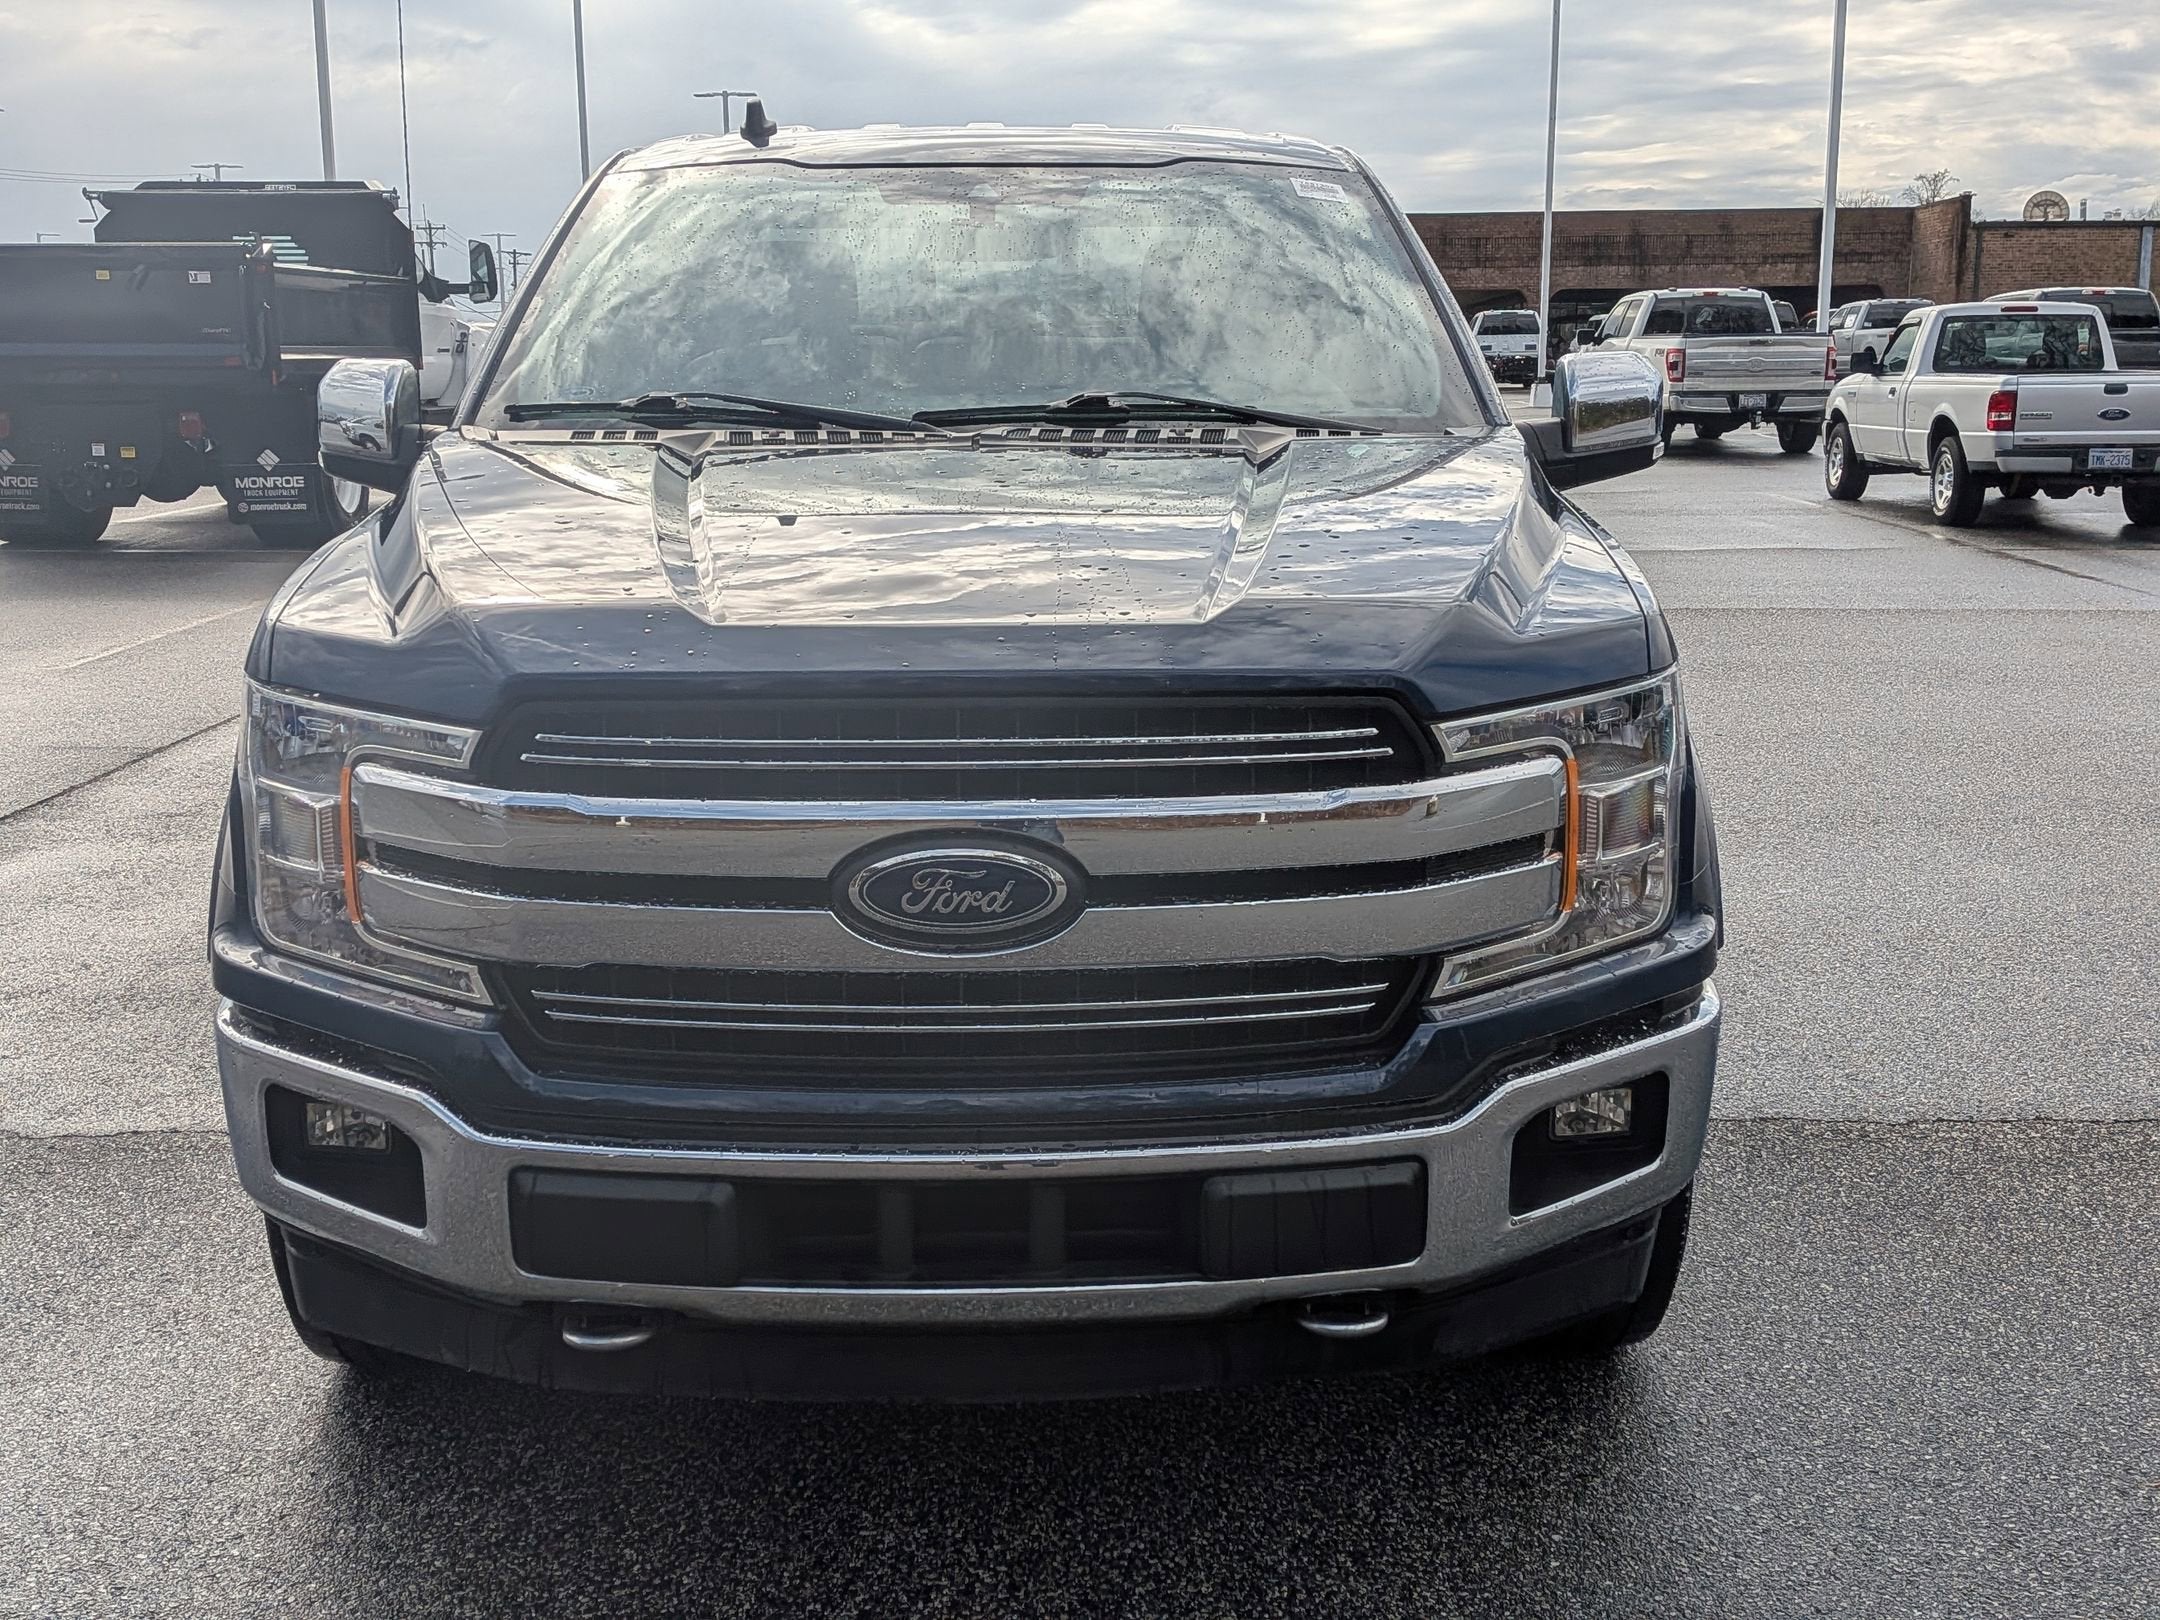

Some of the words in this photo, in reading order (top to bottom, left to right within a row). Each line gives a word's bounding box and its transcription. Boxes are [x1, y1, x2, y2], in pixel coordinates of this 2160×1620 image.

[2091, 454, 2130, 466] TMK-2375
[234, 476, 305, 488] MONROE
[243, 489, 263, 497] TRUCK
[265, 488, 299, 496] EQUIPMENT
[250, 502, 307, 511] monroetruck.com
[901, 867, 1016, 914] Ford
